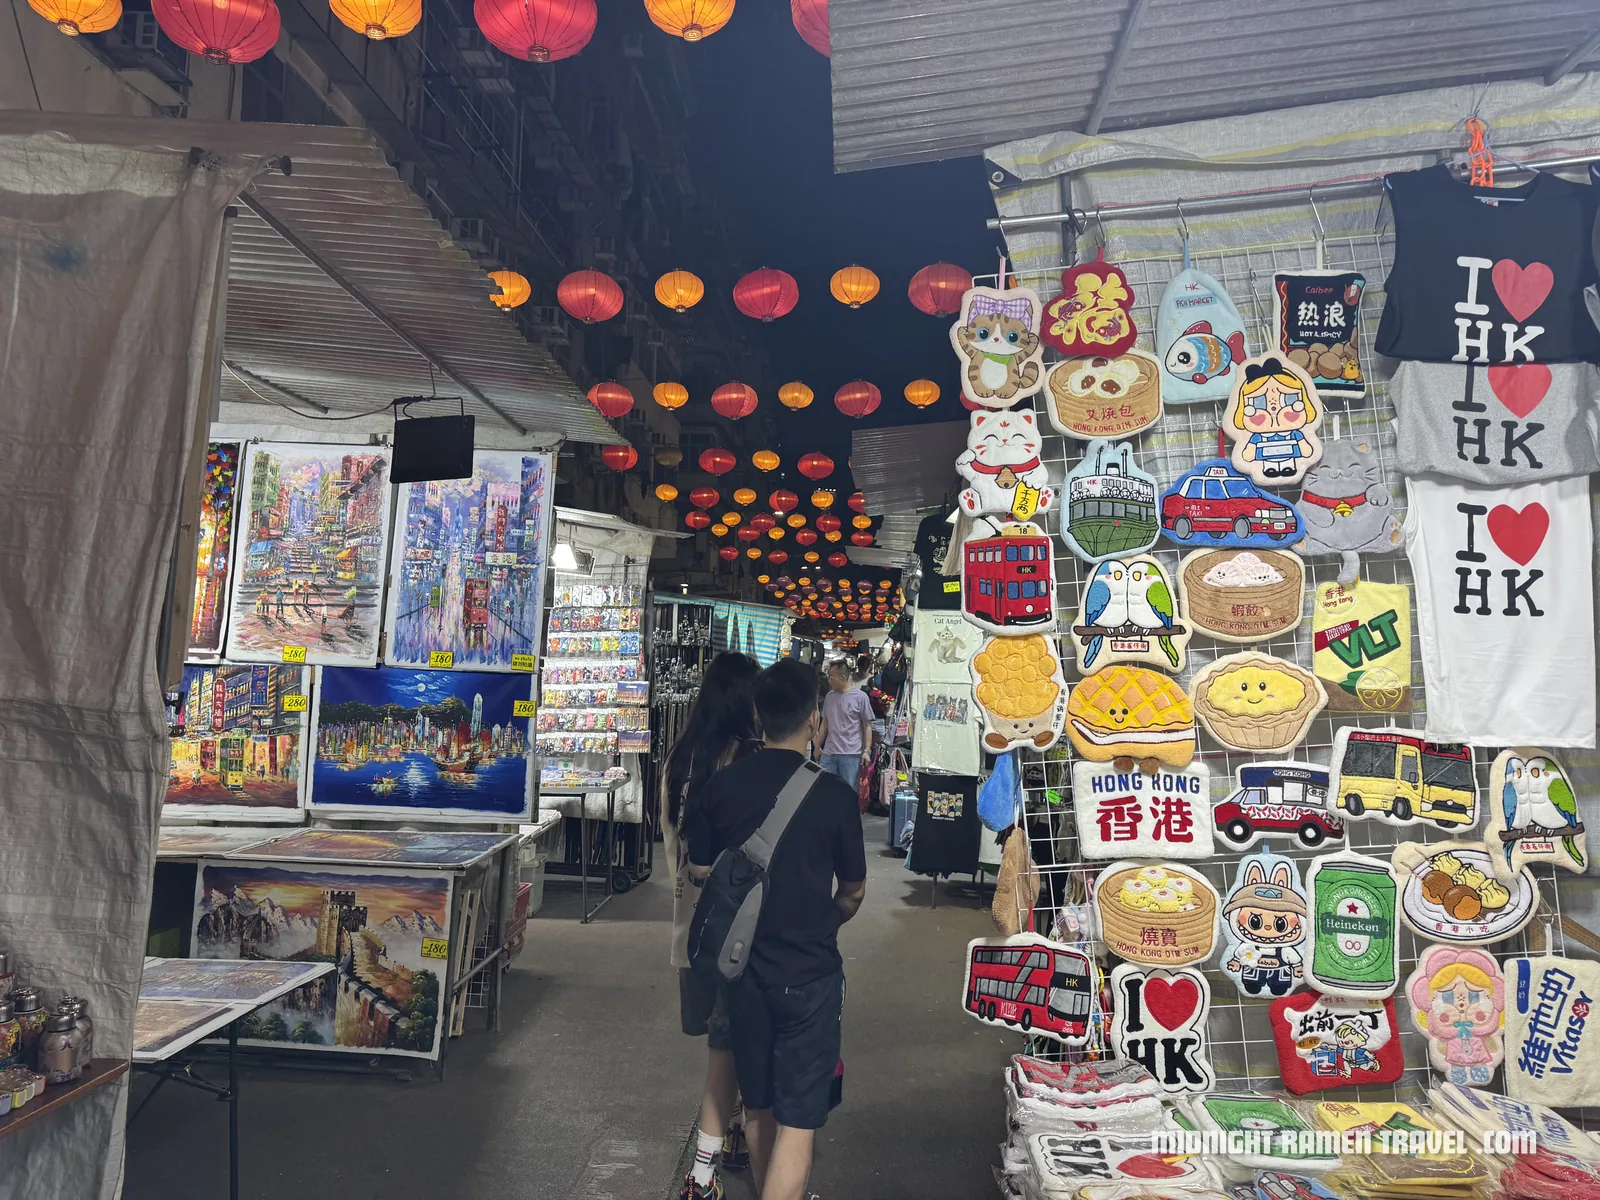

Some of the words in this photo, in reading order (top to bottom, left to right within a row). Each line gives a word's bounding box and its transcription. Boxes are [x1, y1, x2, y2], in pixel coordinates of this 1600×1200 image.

[1185, 283, 1199, 291] HK
[1454, 256, 1493, 315] I
[1297, 300, 1346, 327] 热浪
[1072, 423, 1091, 432] HONG
[1452, 416, 1545, 469] HK
[1019, 527, 1028, 535] 18
[1455, 502, 1488, 563] I
[1453, 566, 1545, 617] HK
[1205, 617, 1226, 628] HONG
[1328, 608, 1402, 669] VLT
[287, 649, 305, 658] 180
[433, 654, 451, 663] 180
[287, 698, 306, 707] 280
[517, 703, 534, 712] 180
[1091, 772, 1143, 794] HONG
[1151, 773, 1201, 794] KONG
[1096, 795, 1194, 843] 香港
[1325, 918, 1380, 933] Heineken
[428, 943, 446, 953] 180
[1115, 941, 1138, 955] HONG
[1140, 948, 1162, 957] KONG
[1183, 946, 1200, 956] SUM
[1065, 978, 1079, 987] HK
[1124, 978, 1145, 1033] I
[1299, 1008, 1384, 1036] 出前一丁
[1517, 967, 1576, 1079] 維他奶
